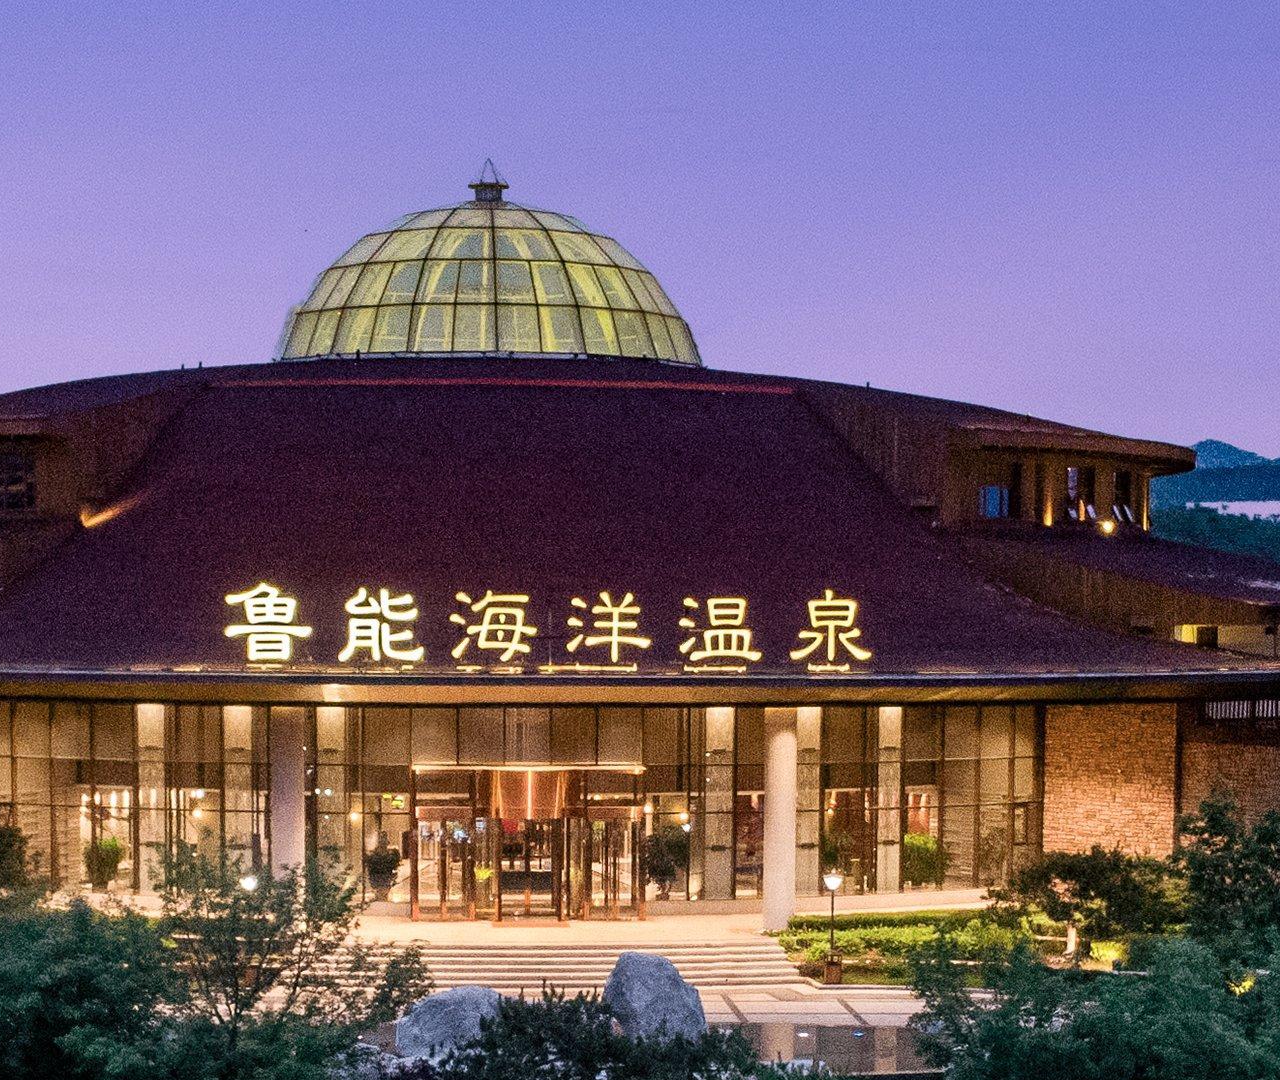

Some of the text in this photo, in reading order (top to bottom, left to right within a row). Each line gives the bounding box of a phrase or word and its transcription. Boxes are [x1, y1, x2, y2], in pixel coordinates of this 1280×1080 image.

[223, 581, 873, 663] 鲁能海洋温泉
